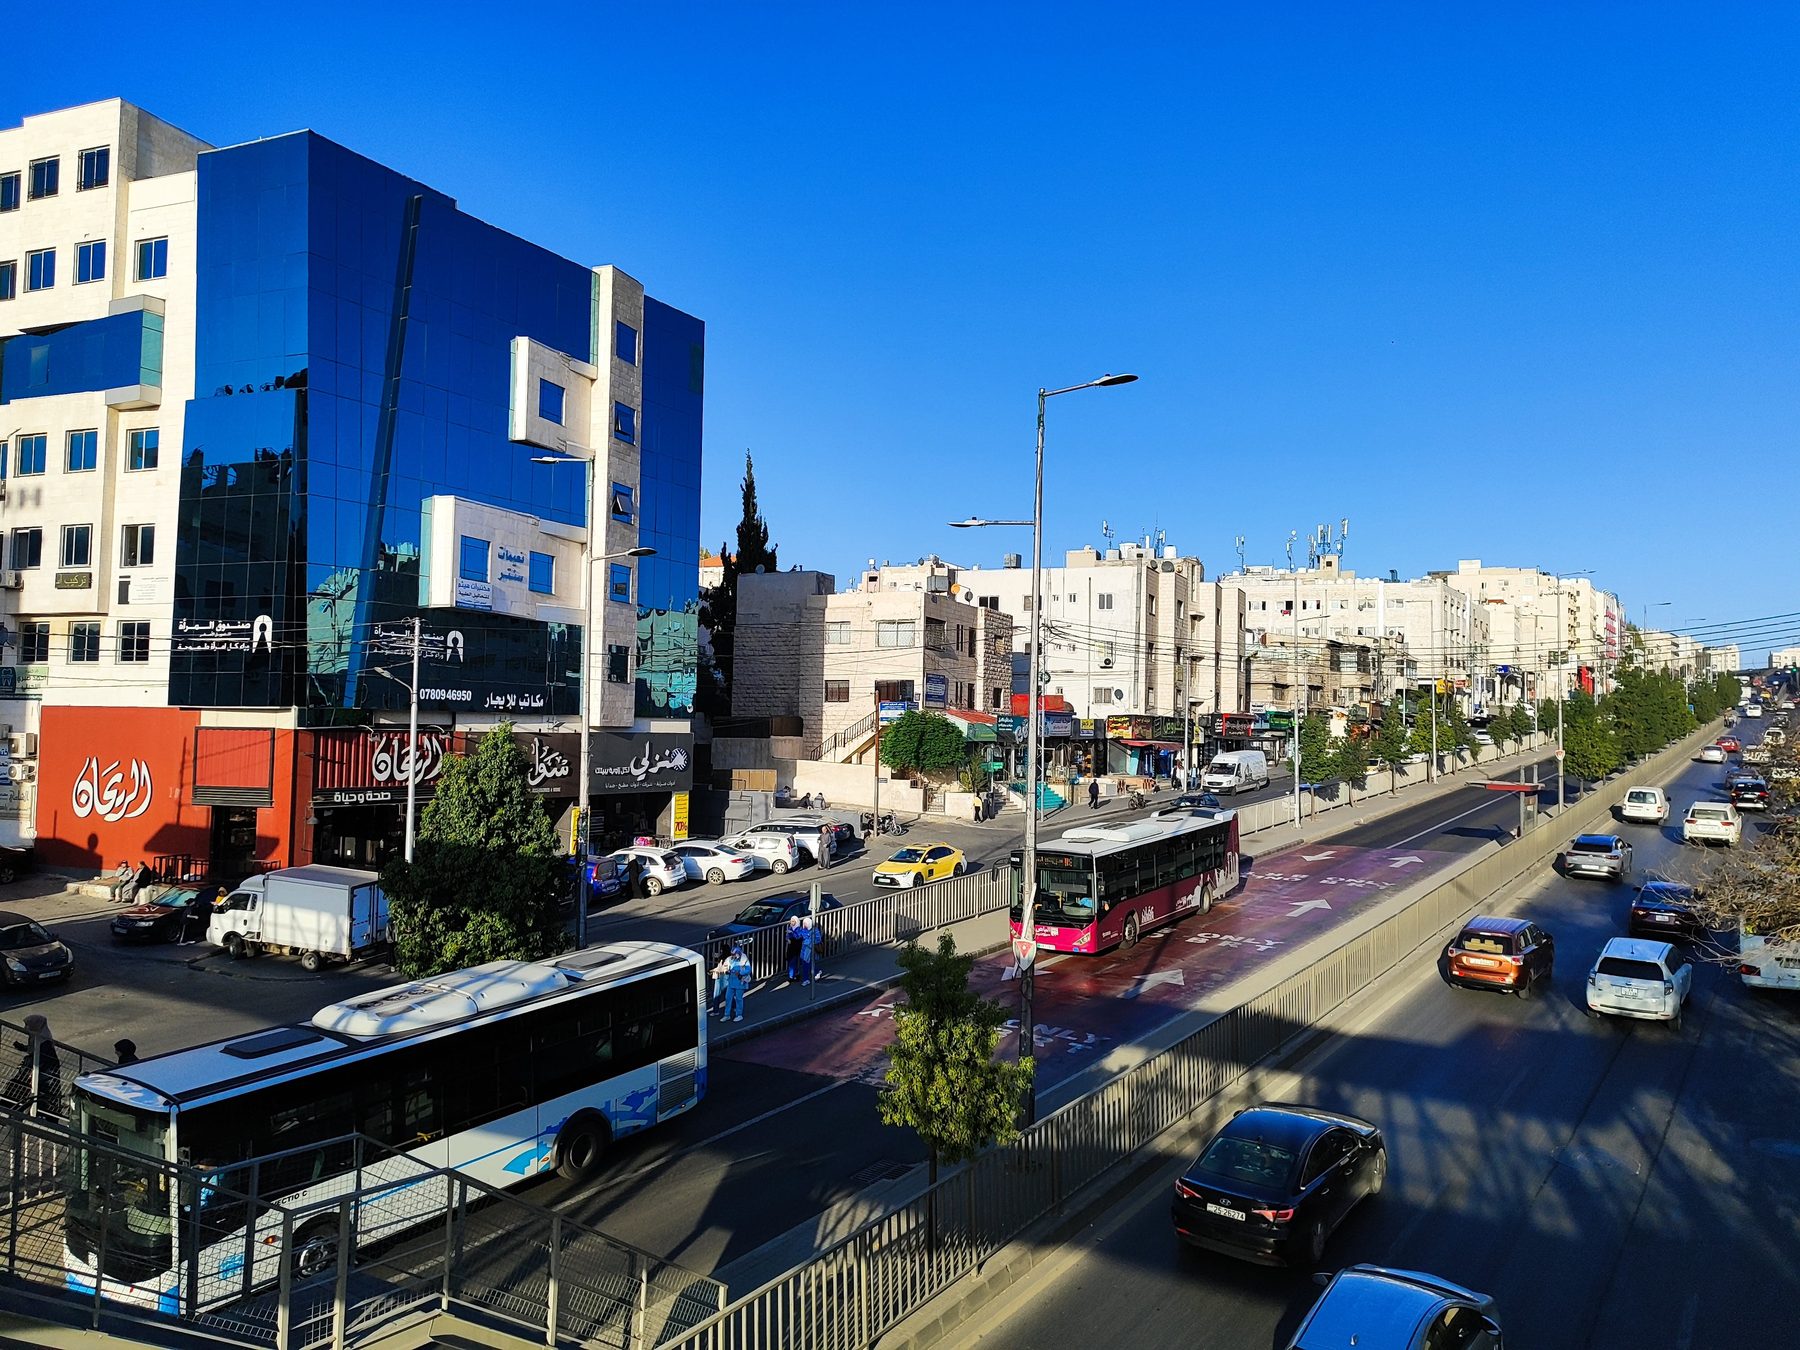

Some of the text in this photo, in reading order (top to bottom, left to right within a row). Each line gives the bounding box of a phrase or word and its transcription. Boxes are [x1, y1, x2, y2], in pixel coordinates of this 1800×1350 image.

[179, 618, 251, 632] صندوق المرأة
[419, 688, 472, 701] 0780946950
[518, 693, 544, 710] مكاتب
[73, 756, 153, 822] الريحان
[334, 791, 391, 804] صحة وحياة
[1197, 932, 1285, 946] ONLY
